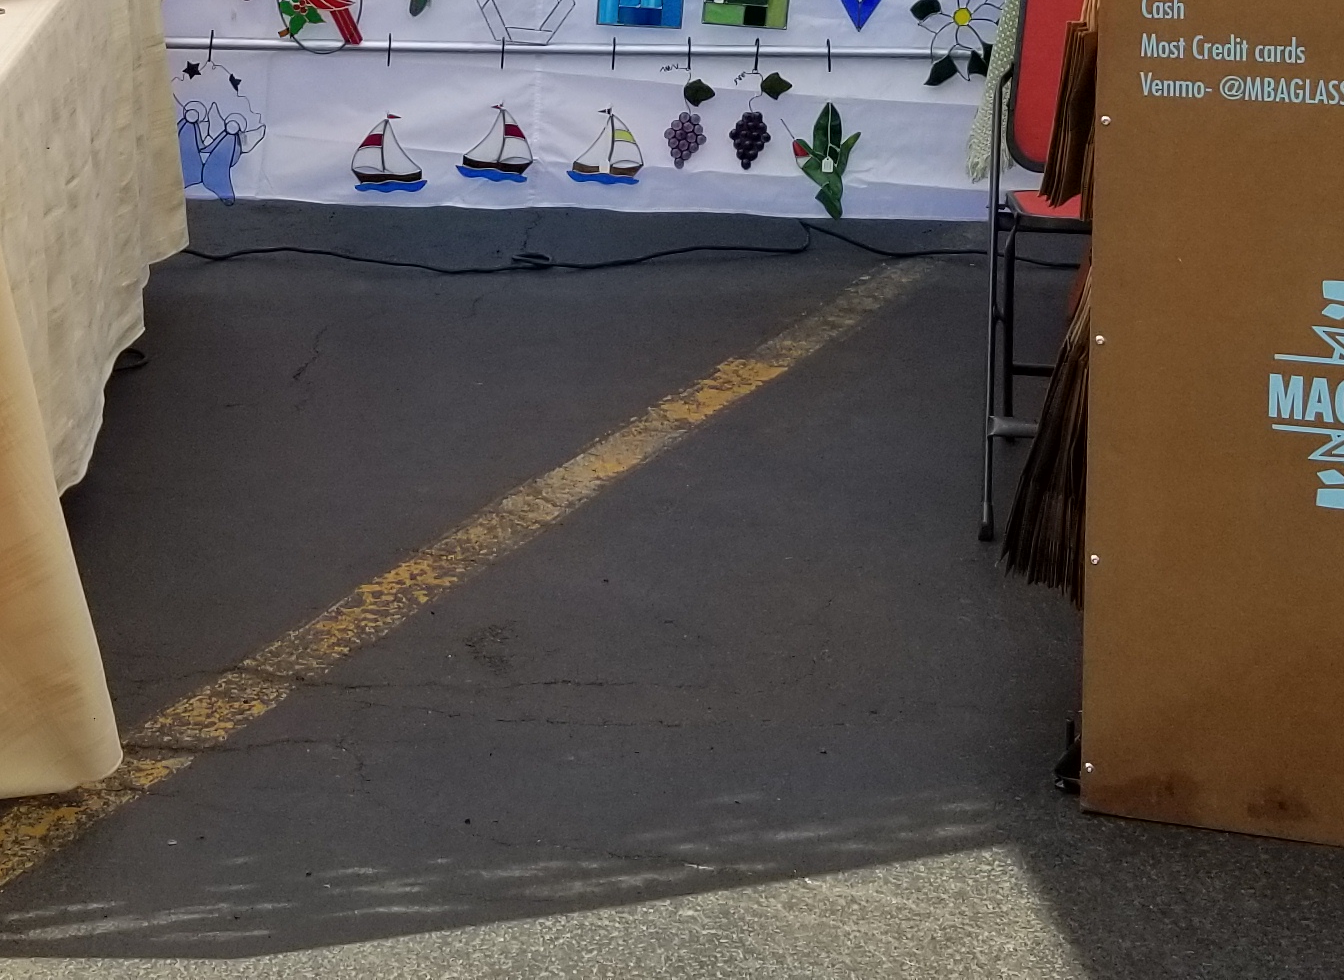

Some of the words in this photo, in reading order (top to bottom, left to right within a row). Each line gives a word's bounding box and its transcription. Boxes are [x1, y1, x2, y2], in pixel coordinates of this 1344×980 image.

[1140, 32, 1186, 59] Most
[1192, 33, 1249, 62] Credit
[1255, 36, 1306, 64] cards
[1140, 72, 1213, 98] Venmo-
